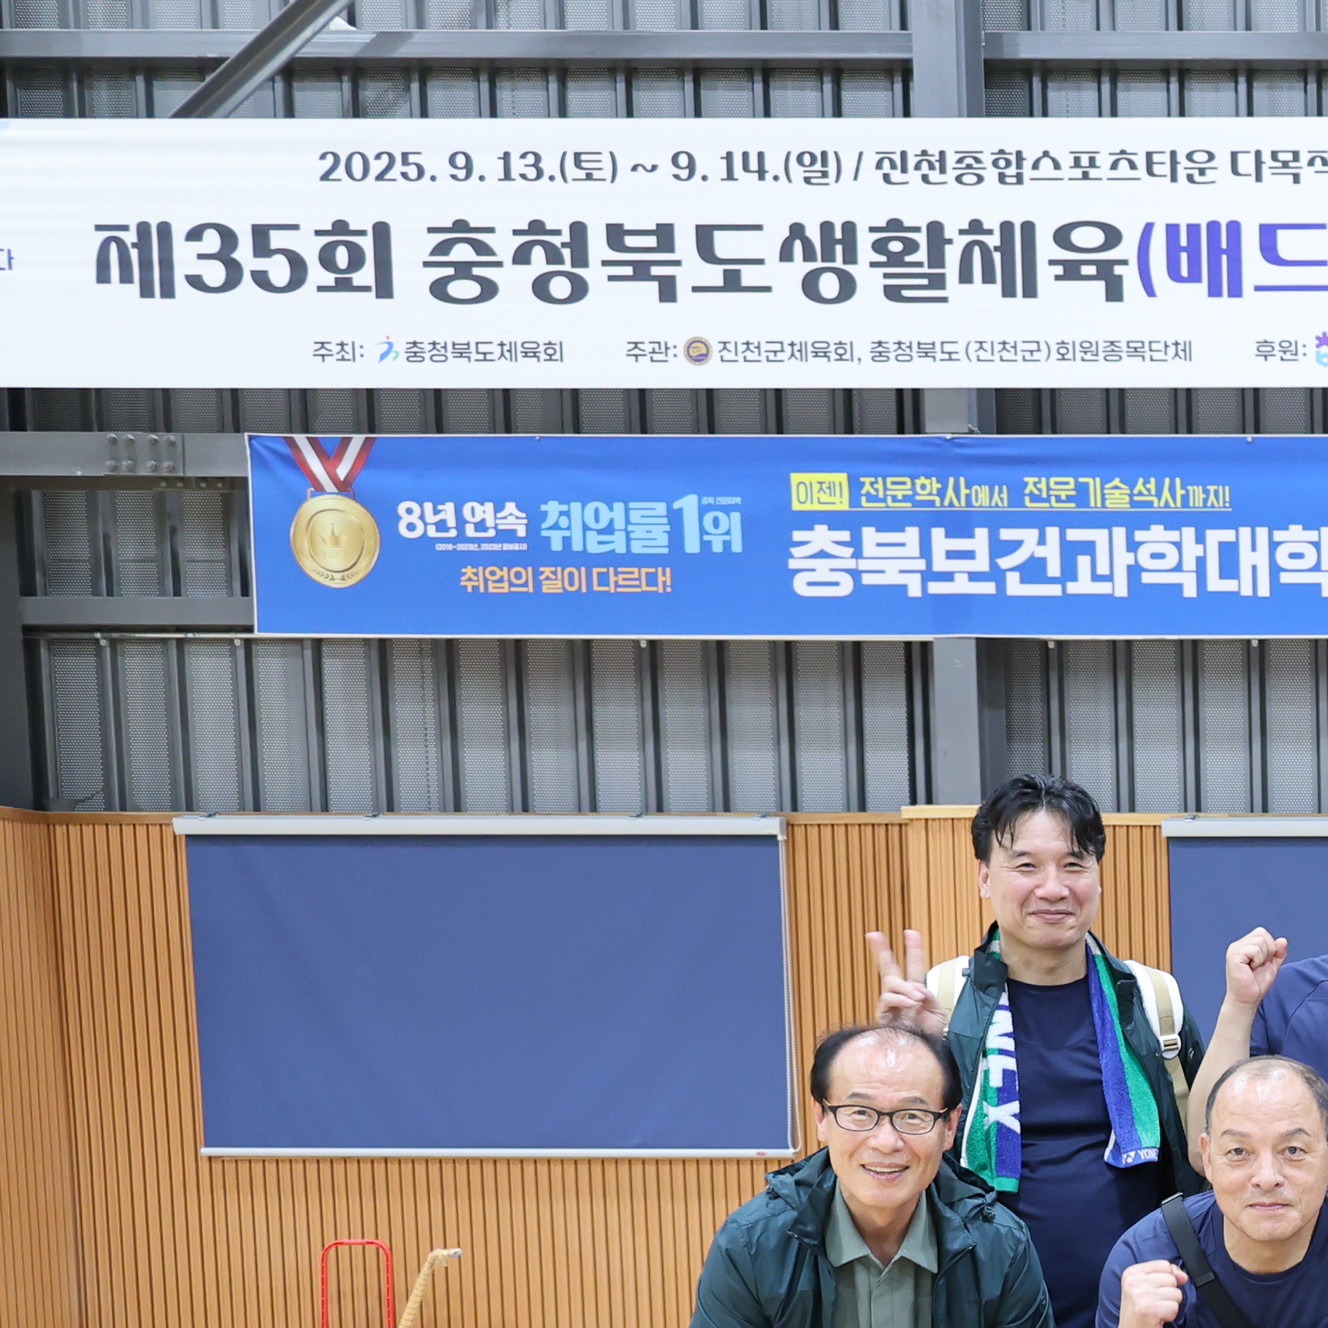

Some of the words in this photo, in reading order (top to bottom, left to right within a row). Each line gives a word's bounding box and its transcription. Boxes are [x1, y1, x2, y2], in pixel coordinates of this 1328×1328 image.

[318, 150, 438, 183] 2025.
[874, 149, 1219, 186] 진천종합스포츠타운
[93, 218, 395, 300] 제35회
[312, 340, 365, 363] 주최:
[404, 339, 564, 364] 충청북도체육회
[625, 340, 678, 363] 주관:
[717, 339, 862, 365] 진천군체육회,
[1254, 339, 1308, 362] 후원:
[796, 479, 844, 505] 이젠!
[859, 476, 1009, 508] 전문학사에서
[1022, 476, 1231, 508] 전문기술석사까지!
[397, 501, 458, 538] 8년
[462, 501, 529, 538] 연속
[460, 565, 535, 594] 취업의
[538, 565, 588, 594] 질이
[592, 566, 672, 594] 다르다!
